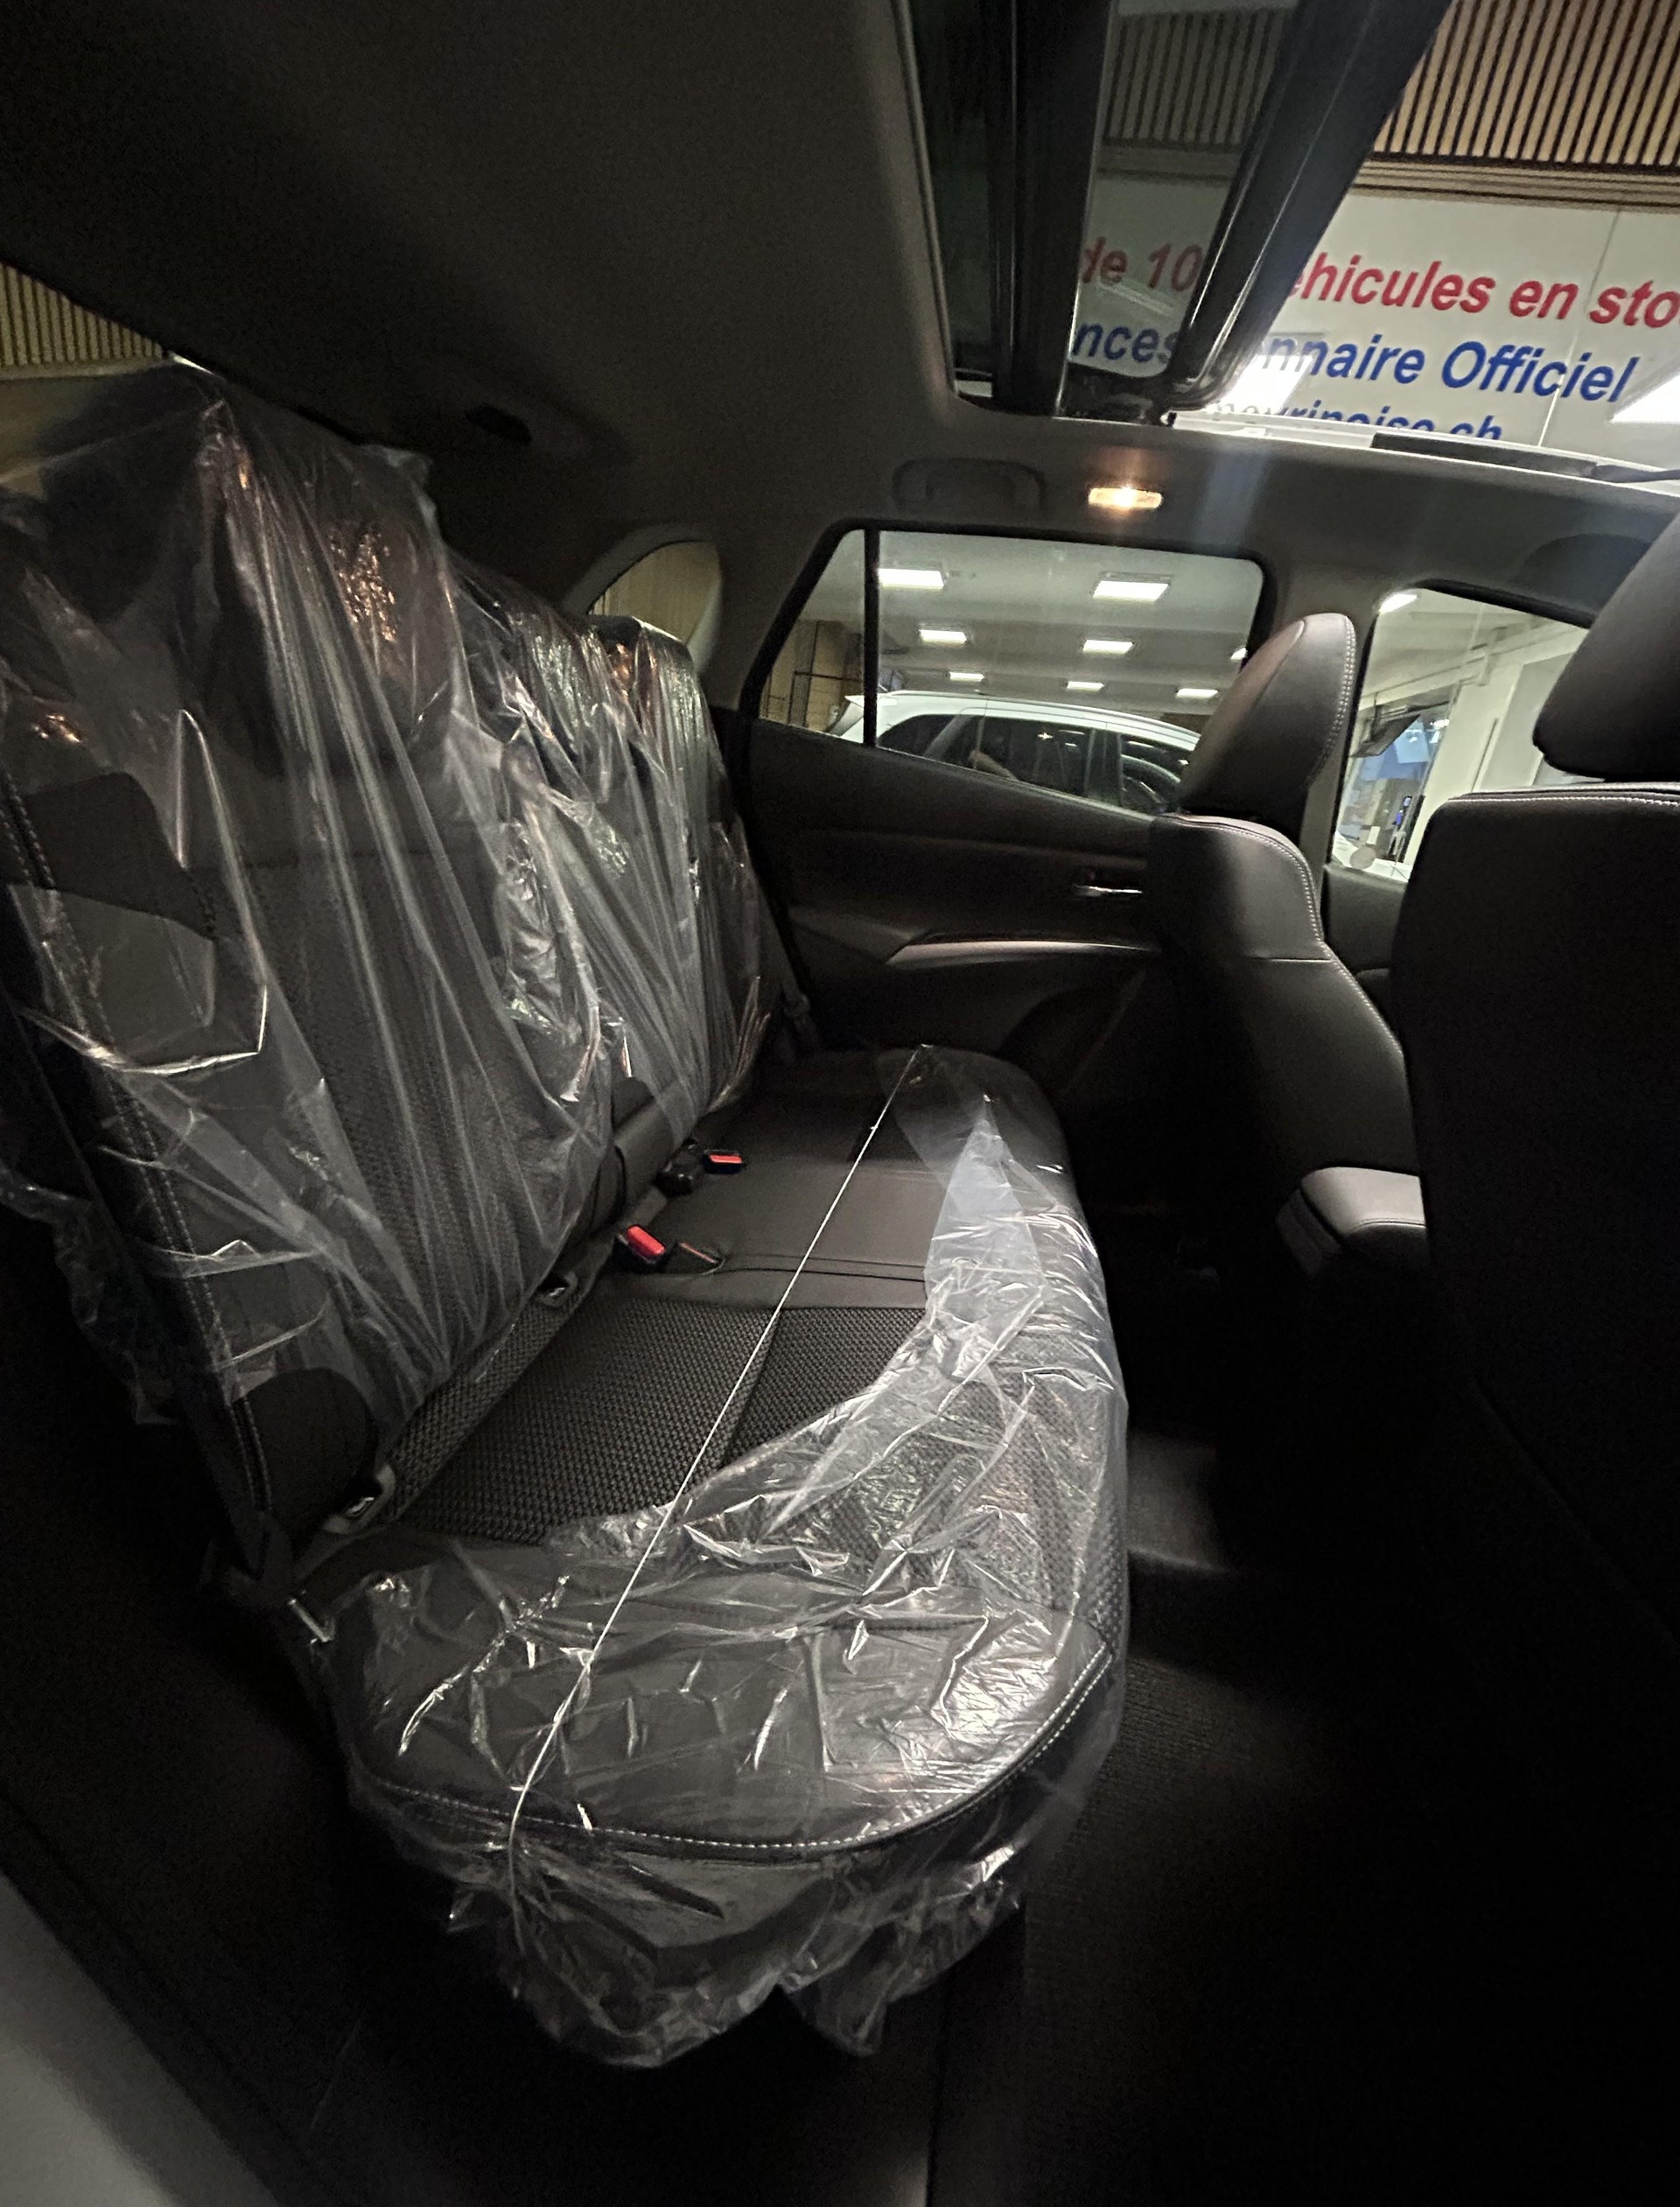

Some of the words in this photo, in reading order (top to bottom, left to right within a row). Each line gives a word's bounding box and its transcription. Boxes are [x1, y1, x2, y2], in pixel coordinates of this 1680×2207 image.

[1147, 242, 1204, 292] 10
[1289, 252, 1495, 313] hicules
[1509, 280, 1578, 320] en
[1588, 280, 1680, 328] sto
[1441, 340, 1641, 403] Officiel
